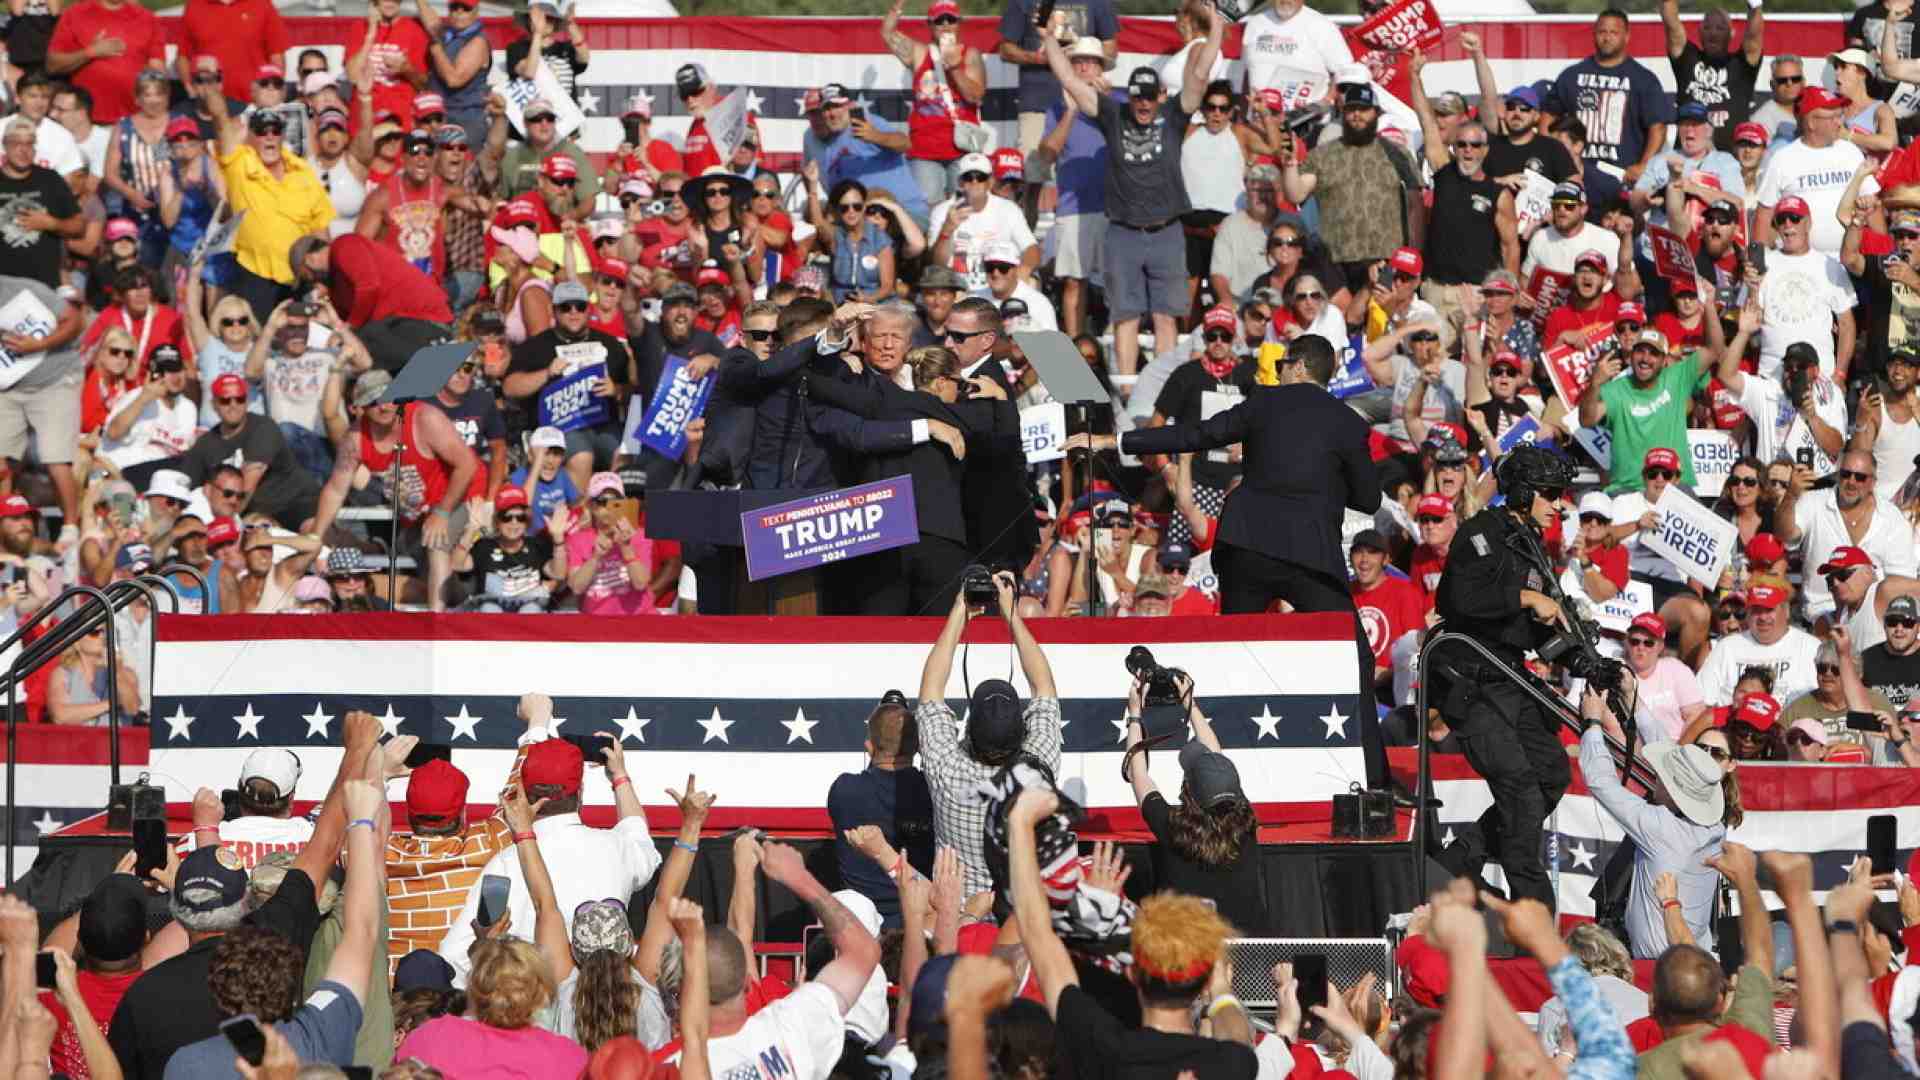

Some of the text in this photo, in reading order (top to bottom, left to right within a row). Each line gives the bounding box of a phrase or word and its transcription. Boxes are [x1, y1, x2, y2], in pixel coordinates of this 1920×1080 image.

[1363, 2, 1426, 45] TRUMP
[1577, 73, 1631, 90] ULTRA
[1798, 171, 1852, 188] TRUMP
[544, 375, 600, 411] TRUMP
[647, 366, 689, 436] TRUMP
[666, 383, 698, 435] 2024
[1695, 461, 1733, 475] OU'RE
[763, 514, 785, 527] TEXT
[786, 499, 851, 522] PENNSYLVANIA
[852, 496, 865, 505] TO
[775, 504, 884, 550] TRUMP
[1664, 510, 1718, 550] YOU'RE
[804, 544, 834, 556] AMERICA
[821, 549, 847, 563] 2024
